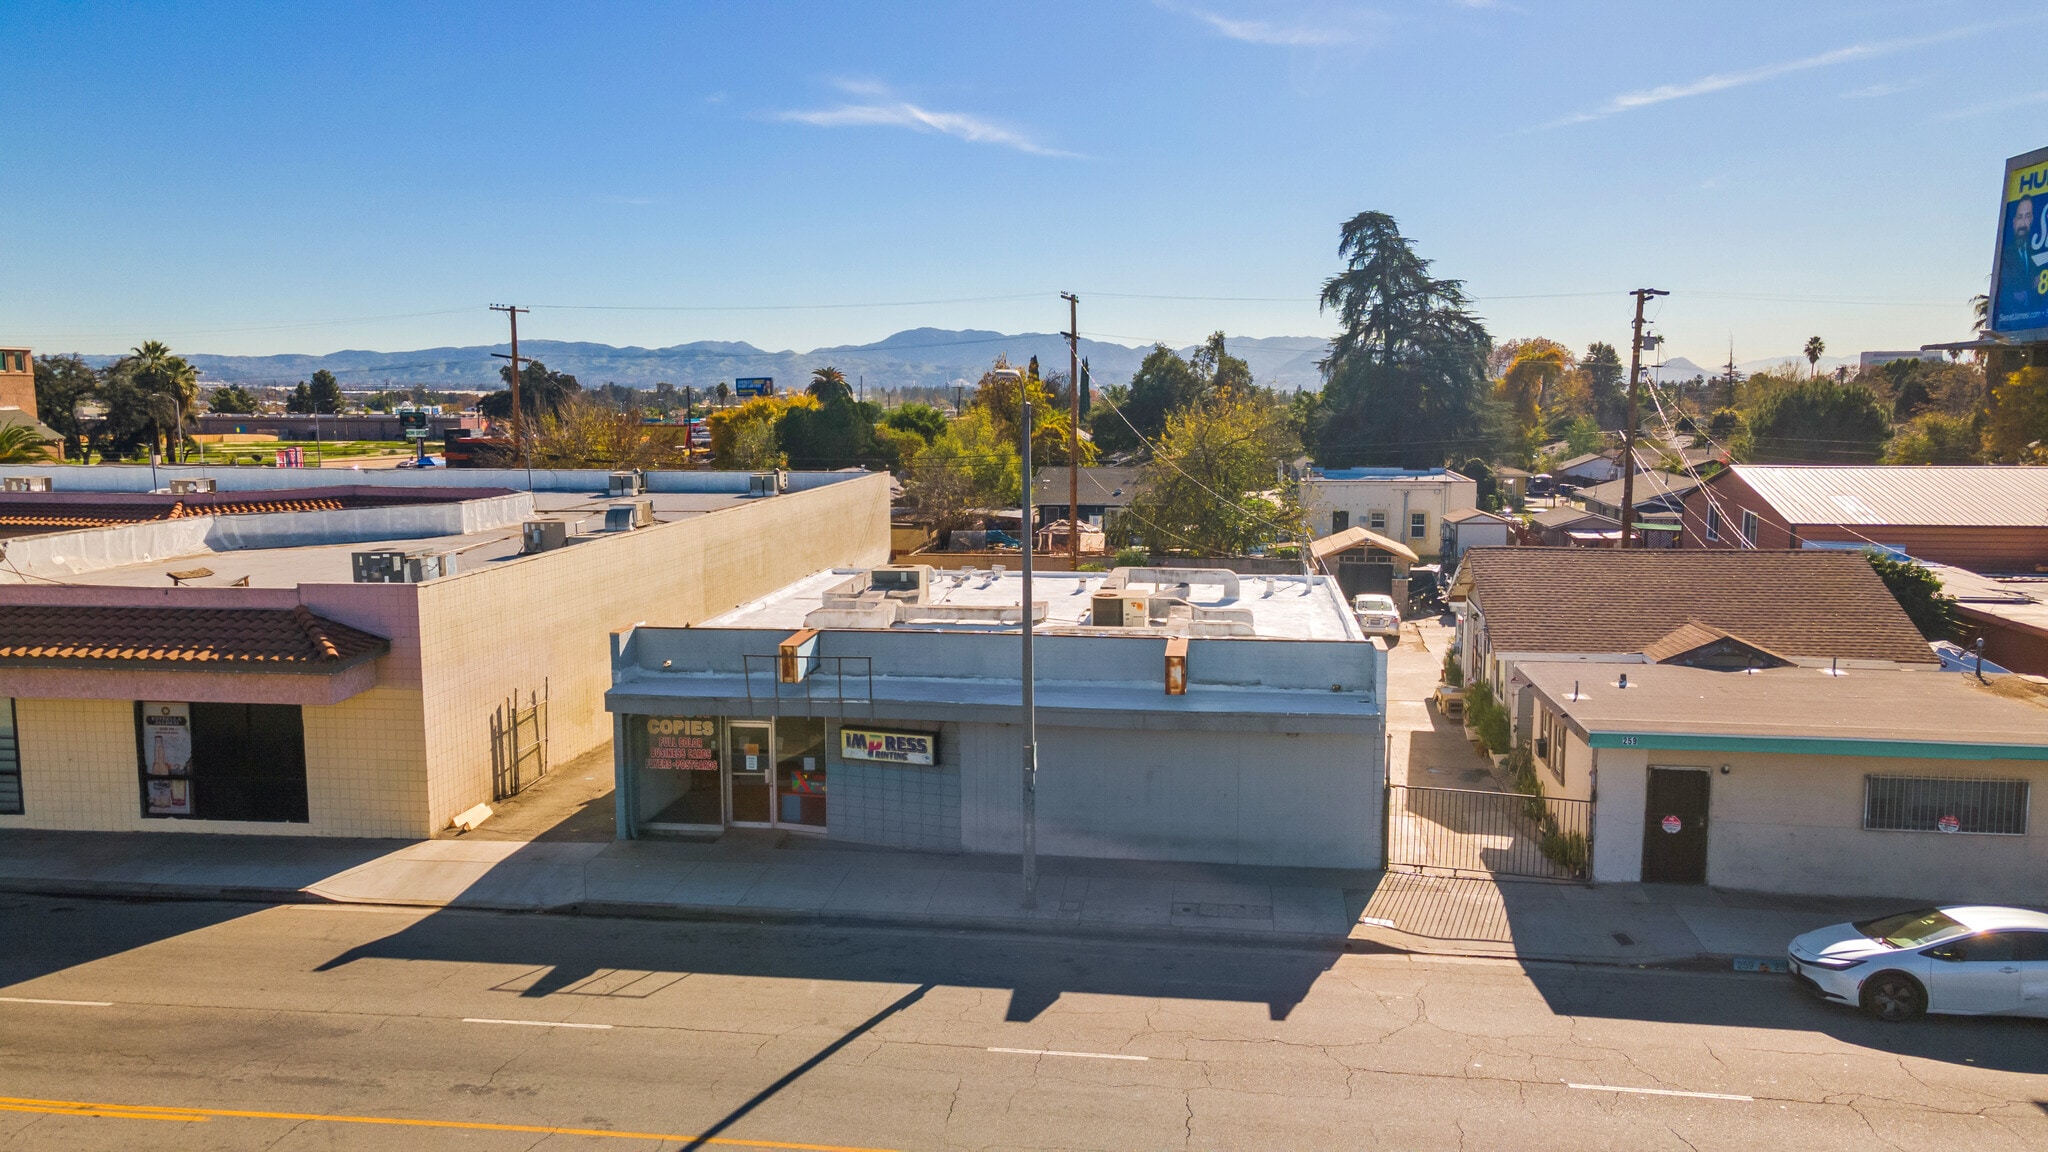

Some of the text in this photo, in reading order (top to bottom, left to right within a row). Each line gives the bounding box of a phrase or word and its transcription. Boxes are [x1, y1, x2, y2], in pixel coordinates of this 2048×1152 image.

[647, 719, 714, 736] COPIES
[658, 737, 703, 748] FULL COLOR
[1623, 736, 1638, 745] 259
[650, 747, 712, 760] BUSINESS CARDS
